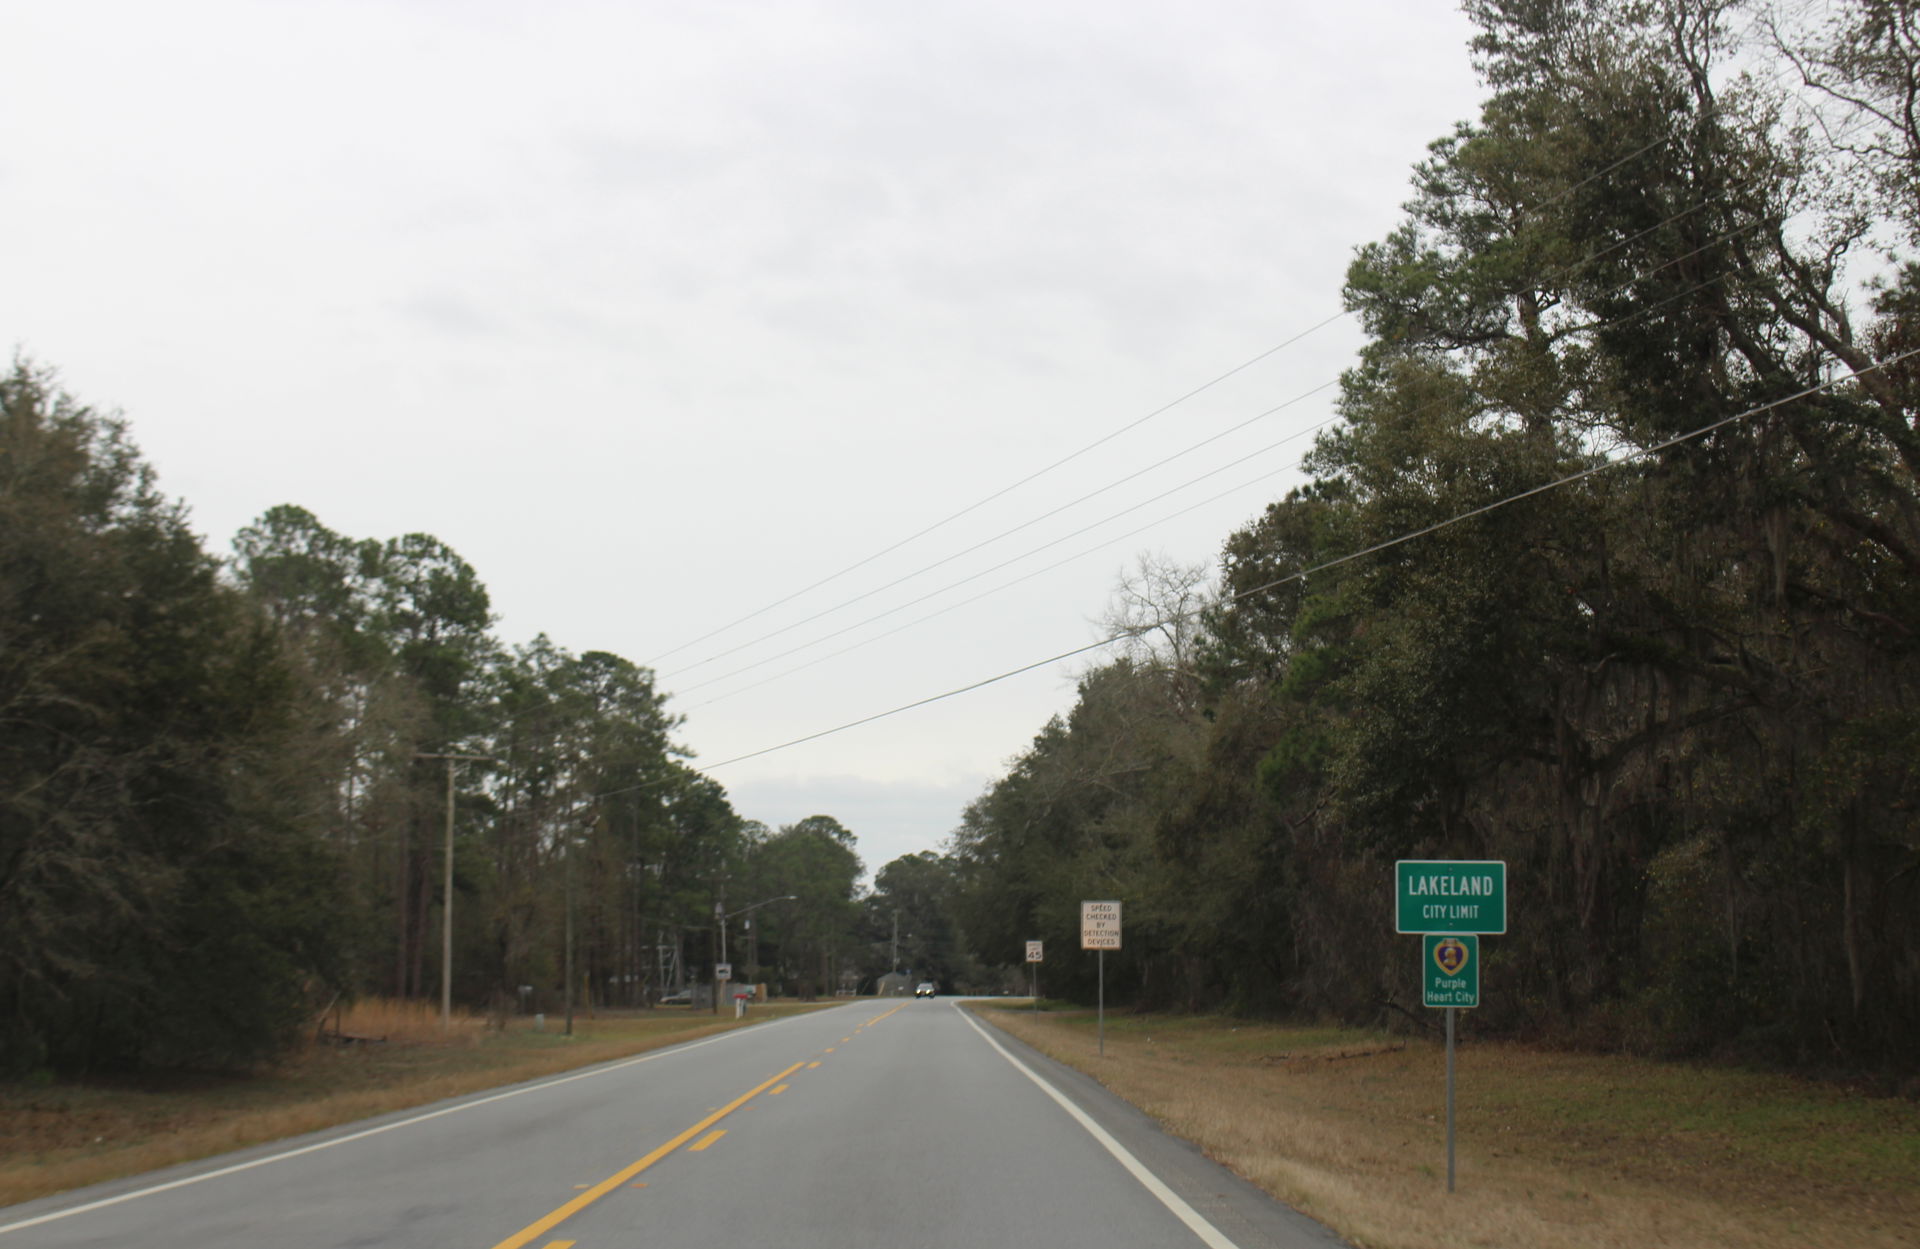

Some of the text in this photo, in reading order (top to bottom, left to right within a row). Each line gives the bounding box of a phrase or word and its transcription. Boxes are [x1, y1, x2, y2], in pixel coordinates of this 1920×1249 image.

[1408, 875, 1494, 896] LAKELAND
[1422, 905, 1479, 919] CITY LIMIT
[1435, 977, 1467, 990] Purple
[1427, 991, 1475, 1004] Heart City
